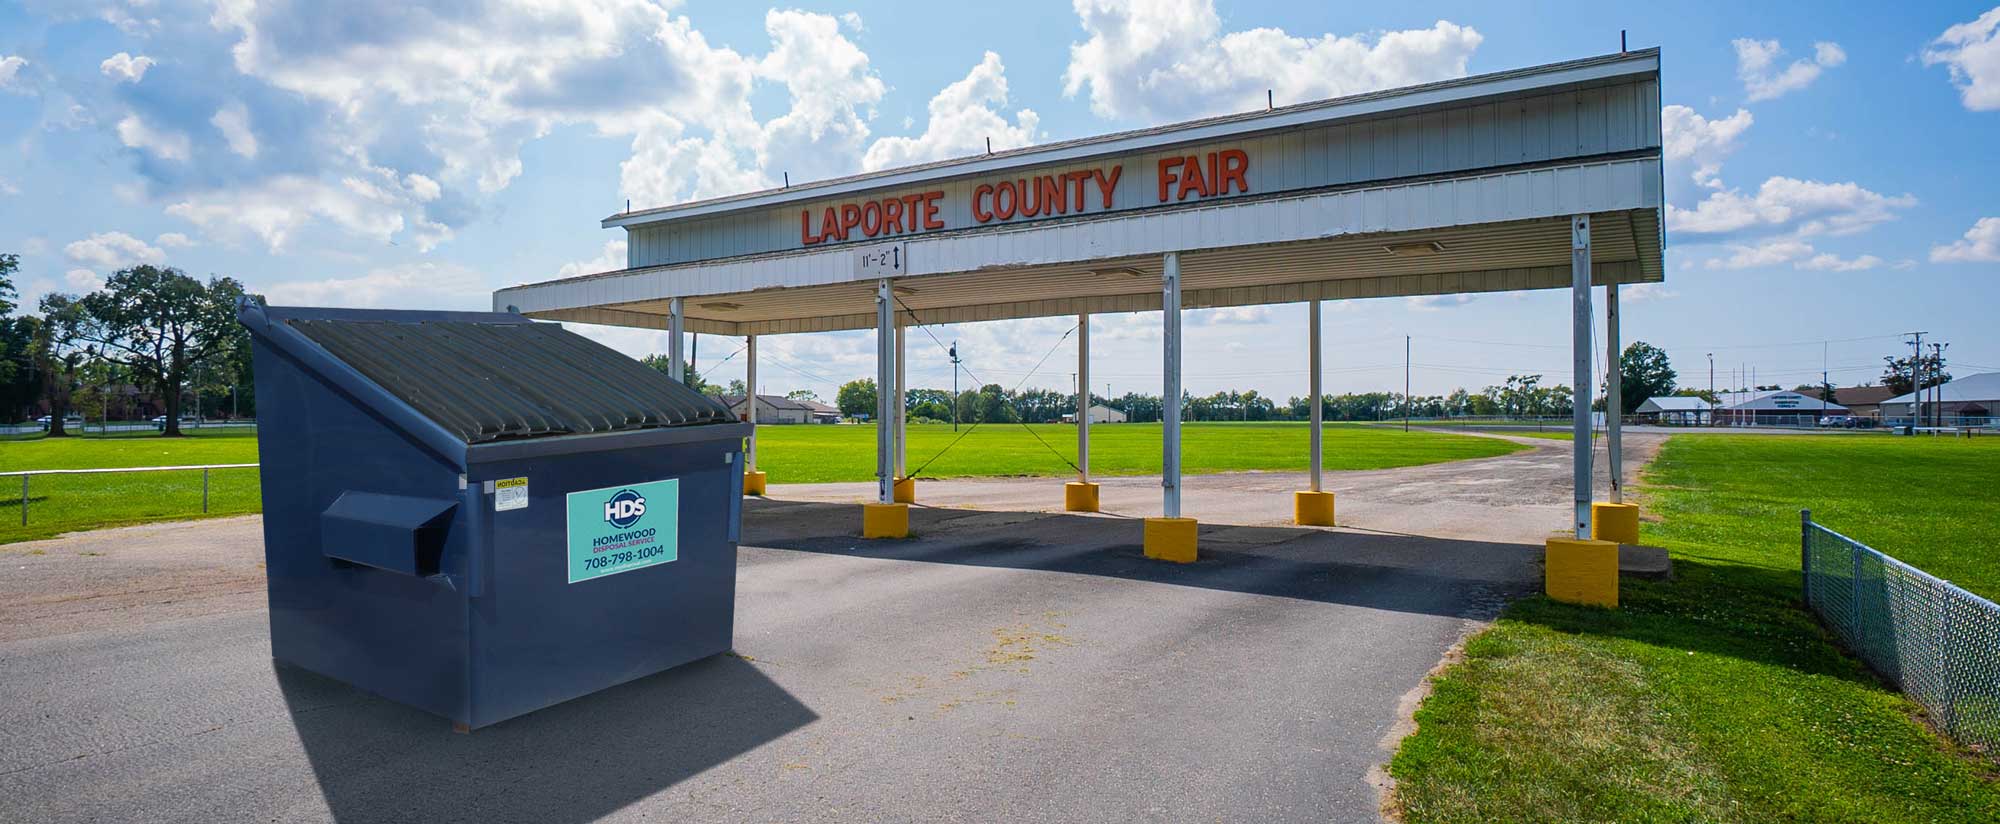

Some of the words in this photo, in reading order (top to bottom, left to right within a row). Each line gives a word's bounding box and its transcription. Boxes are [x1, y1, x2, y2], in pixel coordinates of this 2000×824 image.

[801, 190, 944, 246] LAPORTE
[971, 165, 1122, 223] COUNTY
[1157, 149, 1249, 202] FAIR
[603, 496, 646, 522] HDS
[593, 528, 656, 547] HOMEWOOD
[593, 541, 626, 554] DISPOSAL
[628, 537, 656, 547] SERVICE
[584, 545, 664, 570] 708-798-1004
